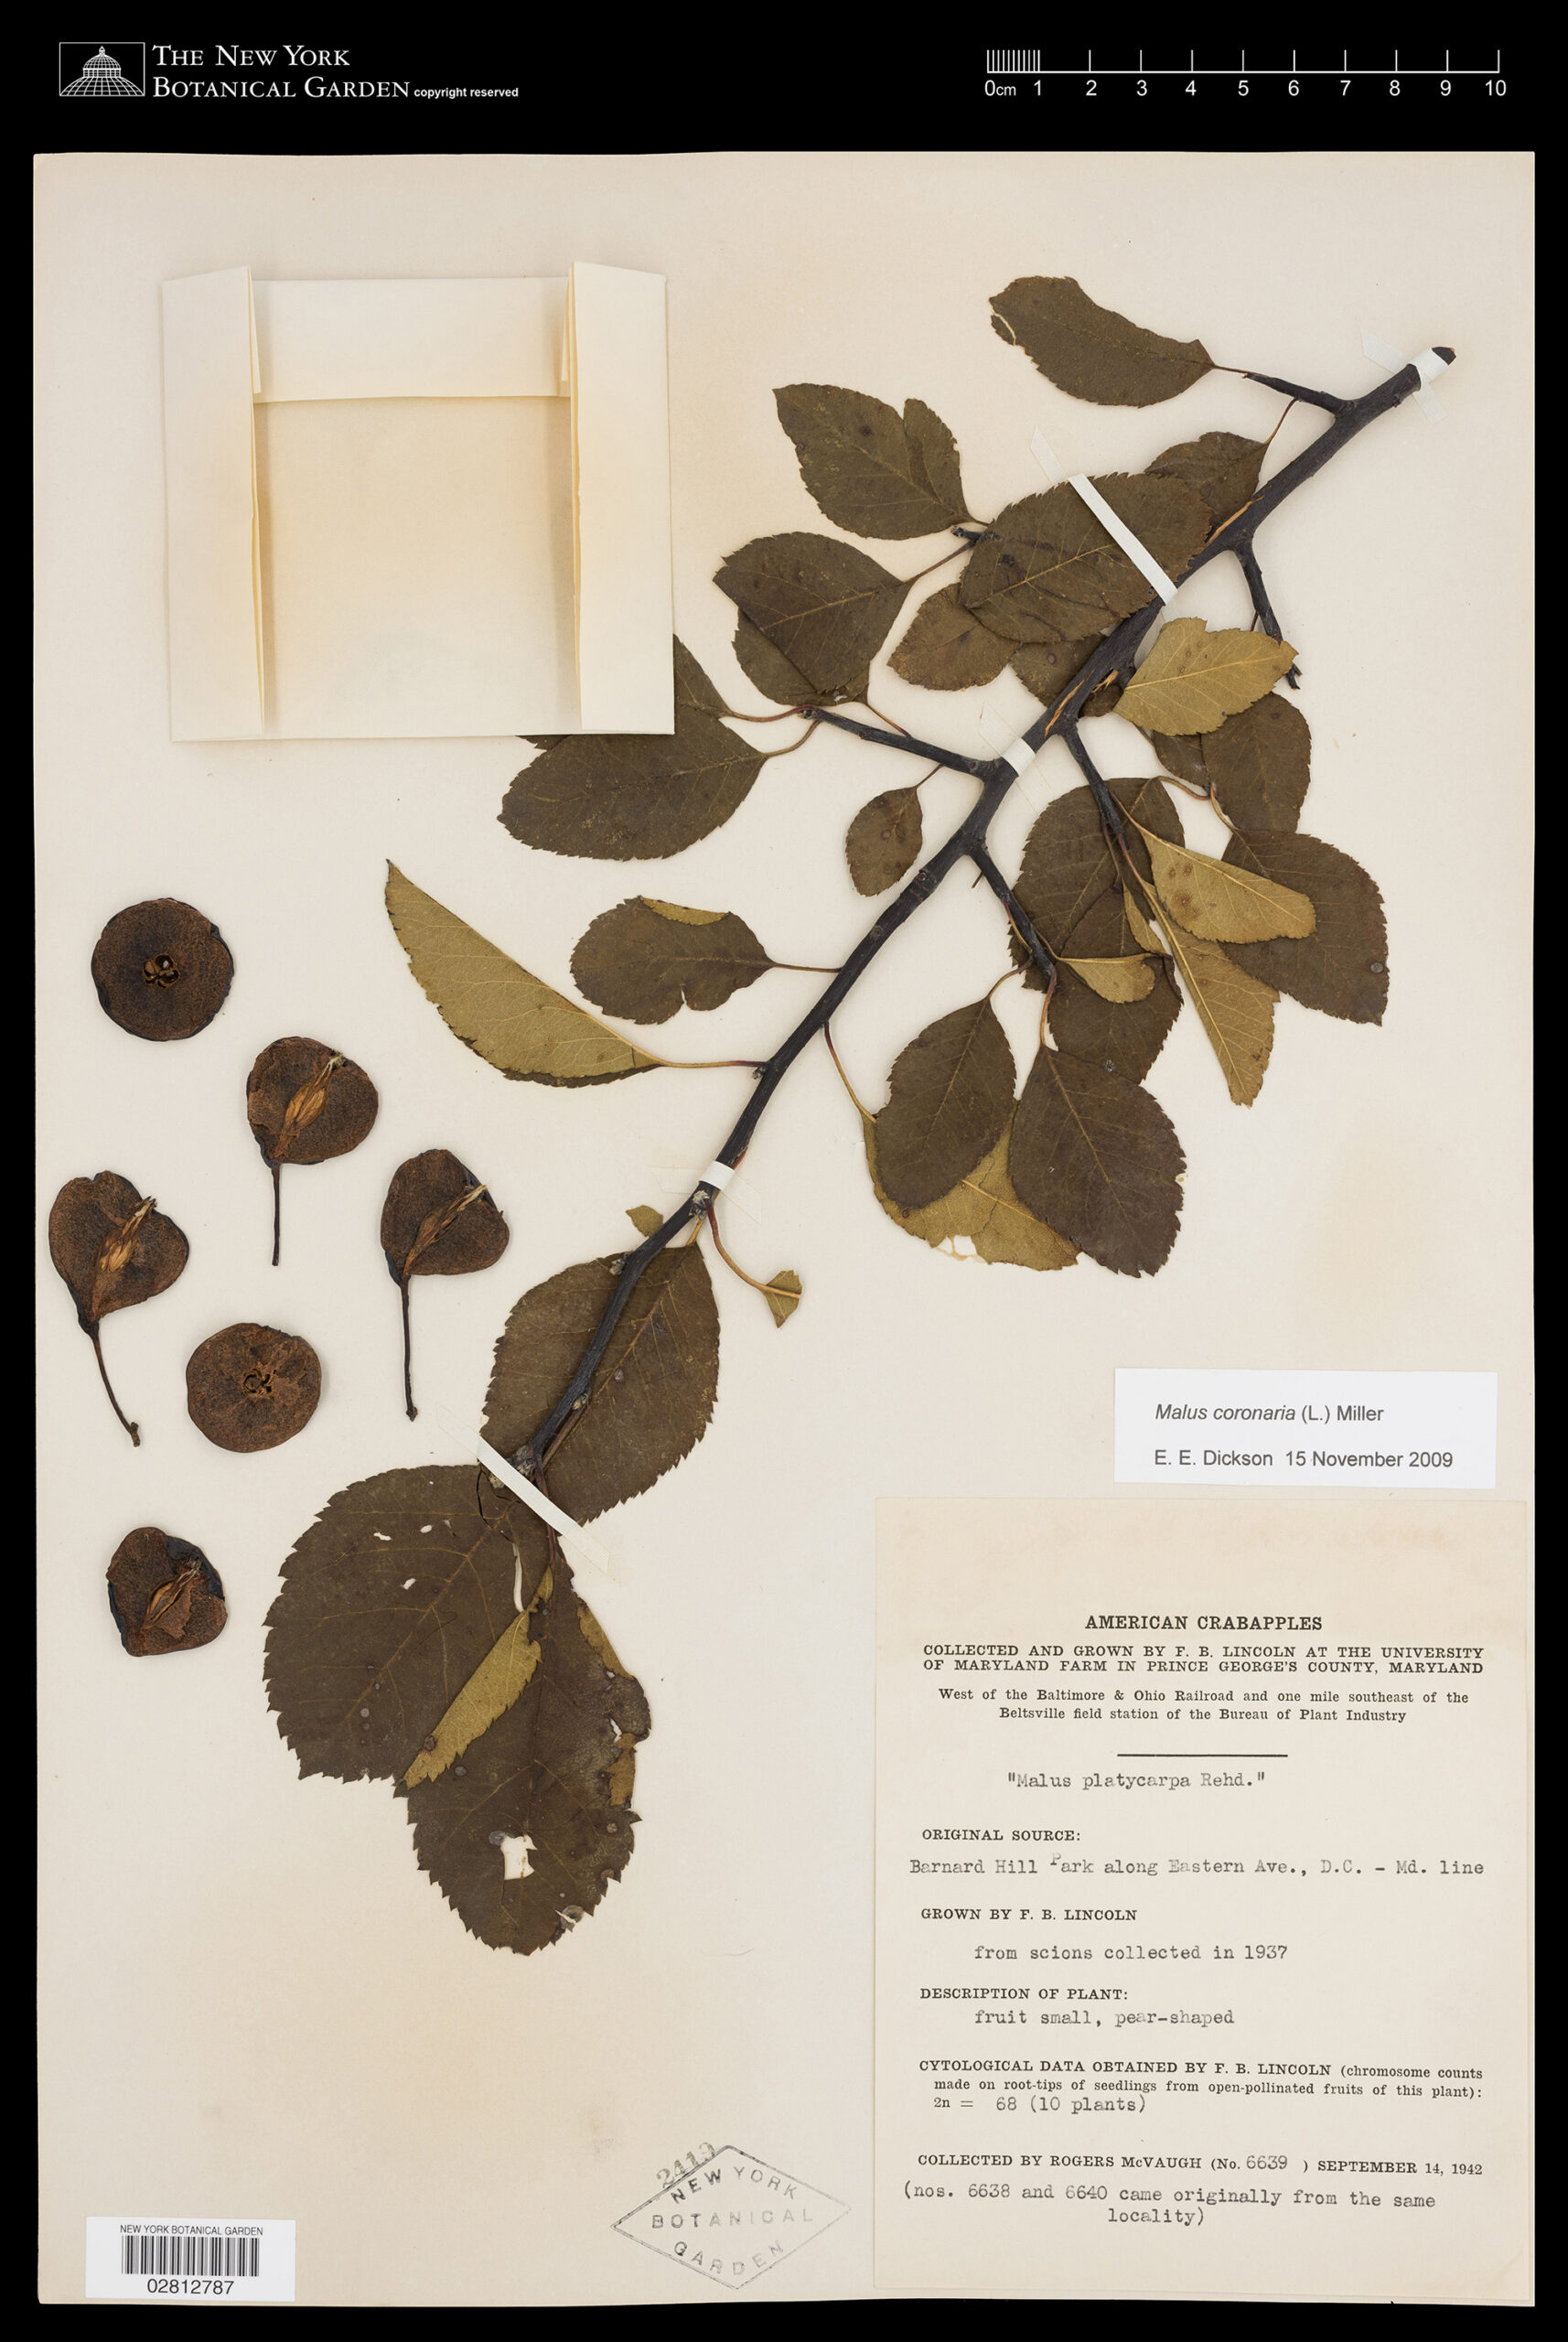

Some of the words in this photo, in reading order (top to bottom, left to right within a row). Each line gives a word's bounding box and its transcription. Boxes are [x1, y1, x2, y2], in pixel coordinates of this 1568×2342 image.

[1155, 1403, 1208, 1421] Malus
[1212, 1404, 1296, 1422] coronaria
[1301, 1404, 1331, 1425] (L.)
[1337, 1404, 1385, 1422] Miller
[1155, 1448, 1172, 1466] E.
[1178, 1449, 1197, 1466] E.
[1203, 1449, 1273, 1466] Dickson
[1285, 1450, 1306, 1467] 15
[1312, 1450, 1404, 1467] November
[1408, 1451, 1454, 1468] 2009
[1084, 1615, 1189, 1630] AMERICAN
[1197, 1615, 1323, 1631] CRABAPPLES
[923, 1644, 1019, 1657] COLLECTED
[1027, 1645, 1064, 1657] AND
[1073, 1645, 1134, 1657] GROWN
[1143, 1645, 1166, 1658] BY
[1175, 1646, 1189, 1658] F.
[1197, 1645, 1214, 1659] B.
[1222, 1646, 1296, 1658] LINCOLN
[1305, 1646, 1328, 1659] AT
[1337, 1646, 1371, 1659] THE
[1380, 1646, 1485, 1660] UNIVERSITY
[923, 1659, 945, 1671] OF
[953, 1659, 1049, 1671] MARYLAND
[1058, 1660, 1108, 1672] FARM
[1116, 1660, 1137, 1672] IN
[1146, 1660, 1208, 1672] PRINCE
[1219, 1660, 1298, 1673] GEORGE'S
[1307, 1660, 1379, 1675] COUNTY,
[1388, 1661, 1484, 1674] MARYLAND
[938, 1688, 974, 1701] West
[982, 1688, 998, 1701] of
[1004, 1688, 1028, 1701] the
[1036, 1689, 1105, 1702] Baltimore
[1113, 1689, 1125, 1702] &
[1133, 1690, 1166, 1702] Ohio
[1174, 1690, 1235, 1702] Railroad
[1242, 1690, 1269, 1702] and
[1277, 1692, 1302, 1703] one
[1309, 1690, 1340, 1703] mile
[1348, 1691, 1414, 1703] southeast
[1422, 1691, 1438, 1703] of
[1445, 1692, 1469, 1704] the
[998, 1706, 1066, 1720] Beltsville
[1072, 1707, 1103, 1720] field
[1110, 1707, 1159, 1720] station
[1166, 1708, 1182, 1720] of
[1188, 1708, 1211, 1720] the
[1219, 1708, 1269, 1721] Bureau
[1276, 1708, 1292, 1720] of
[1299, 1708, 1338, 1721] Plant
[1346, 1709, 1407, 1724] Industry
[1007, 1771, 1071, 1789] "Malus
[1081, 1772, 1192, 1791] platycarpa
[1200, 1771, 1265, 1788] Rehd."
[921, 1829, 1004, 1842] ORIGINAL
[1011, 1830, 1080, 1842] SOURCE:
[909, 1859, 986, 1874] Barnard
[994, 1859, 1038, 1875] Hill
[1049, 1853, 1094, 1874] Park
[1103, 1858, 1158, 1877] along
[1167, 1858, 1245, 1874] Eastern
[1254, 1859, 1307, 1877] Ave.,
[1320, 1859, 1362, 1875] D.C.
[1395, 1859, 1427, 1875] Md.
[1439, 1859, 1485, 1875] line
[920, 1907, 982, 1920] GROWN
[989, 1908, 1013, 1920] BY
[1019, 1908, 1034, 1920] F.
[1041, 1908, 1057, 1921] B.
[1063, 1908, 1138, 1921] LINCOLN
[974, 1945, 1018, 1961] from
[1029, 1945, 1093, 1961] scions
[1103, 1944, 1202, 1961] collected
[1213, 1945, 1235, 1960] in
[1244, 1944, 1288, 1961] 1937
[919, 1987, 1031, 2000] DESCRIPTION
[1037, 1988, 1059, 2000] OF
[1066, 1988, 1128, 2001] PLANT:
[974, 2009, 1027, 2025] fruit
[1040, 2009, 1101, 2028] small,
[1114, 2009, 1236, 2028] pear-shaped
[918, 2059, 1034, 2072] CYTOLOGICAL
[1039, 2060, 1086, 2072] DATA
[1091, 2060, 1178, 2073] OBTAINED
[1184, 2061, 1208, 2074] BY
[1214, 2062, 1229, 2074] F.
[1234, 2062, 1251, 2075] B.
[1257, 2063, 1332, 2077] LINCOLN
[1340, 2064, 1431, 2079] (chromosome
[1437, 2068, 1483, 2079] counts
[933, 2078, 971, 2090] made
[978, 2080, 996, 2090] on
[1004, 2079, 1063, 2093] root-tips
[1070, 2079, 1086, 2091] of
[1093, 2079, 1157, 2094] seedlings
[1165, 2079, 1199, 2092] from
[1208, 2081, 1316, 2096] open-pollinated
[1323, 2082, 1364, 2096] fruits
[1371, 2083, 1388, 2096] of
[1395, 2084, 1423, 2097] this
[1431, 2085, 1482, 2100] plant):
[933, 2096, 951, 2109] 2n
[995, 2096, 1017, 2111] 68
[1030, 2094, 1061, 2113] (10
[1070, 2093, 1145, 2115] plants)
[918, 2154, 1014, 2166] COLLECTED
[1019, 2154, 1044, 2166] BY
[1049, 2154, 1115, 2167] ROGERS
[1121, 2155, 1202, 2169] McVAUGH
[1210, 2157, 1240, 2172] (No.
[1246, 2155, 1288, 2171] 6639
[1317, 2160, 1418, 2174] SEPTEMBER
[1424, 2162, 1444, 2177] 14,
[1451, 2163, 1483, 2175] 1942
[671, 2168, 721, 2204] NEW
[733, 2165, 799, 2199] YORK
[904, 2179, 954, 2200] (nos.
[968, 2183, 1011, 2198] 6638
[1021, 2184, 1055, 2199] and
[1065, 2185, 1108, 2200] 6640
[1119, 2188, 1163, 2202] came
[1173, 2187, 1283, 2208] originally
[1293, 2188, 1338, 2206] from
[1349, 2190, 1381, 2207] the
[1393, 2196, 1436, 2208] same
[651, 2208, 813, 2229] BOTANICAL
[1108, 2206, 1204, 2227] locality)
[120, 2224, 142, 2234] NEW
[143, 2224, 170, 2234] YORK
[171, 2225, 222, 2236] BOTANICAL
[224, 2226, 263, 2237] GARDEN
[673, 2240, 784, 2276] GARDEN
[146, 2278, 235, 2295] 02812787
